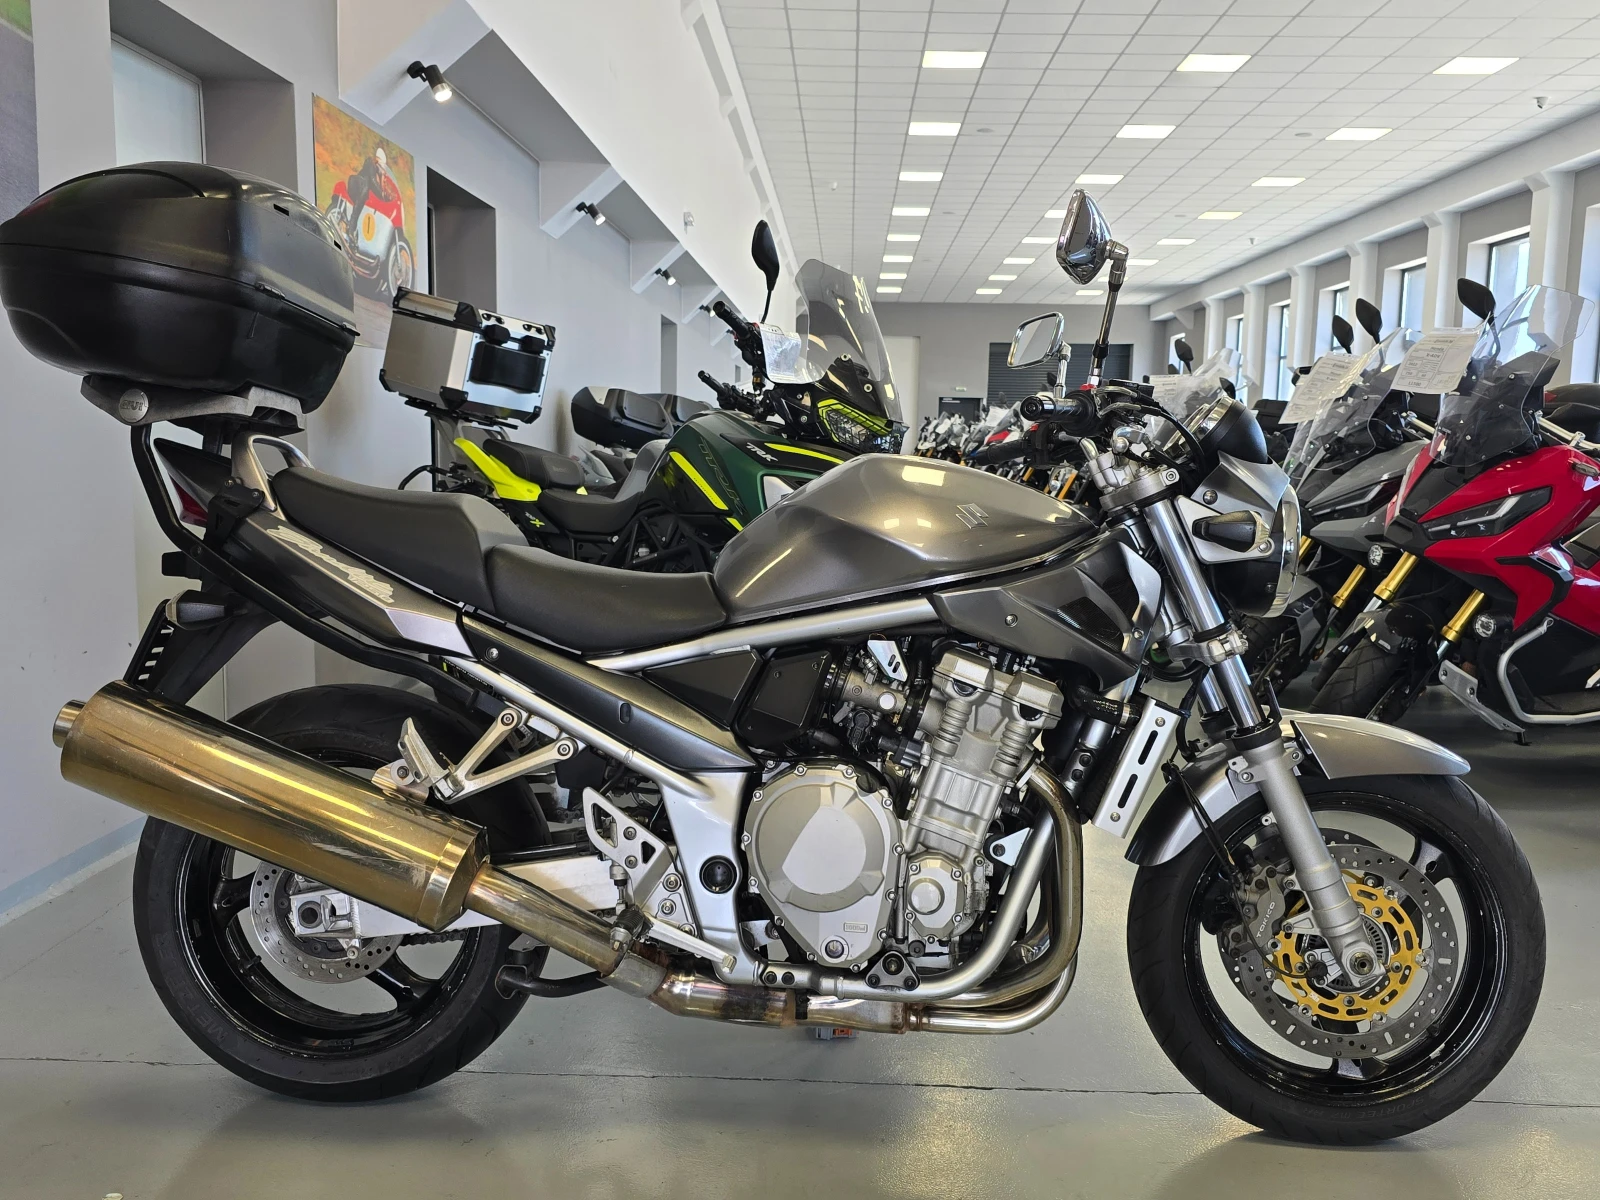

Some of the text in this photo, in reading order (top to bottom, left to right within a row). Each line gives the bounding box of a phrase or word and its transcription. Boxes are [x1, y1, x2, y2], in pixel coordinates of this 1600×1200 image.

[745, 442, 779, 462] TRK
[698, 436, 747, 516] TRK
[1256, 901, 1276, 938] TOKICO
[1356, 1095, 1425, 1119] SPORTEC
